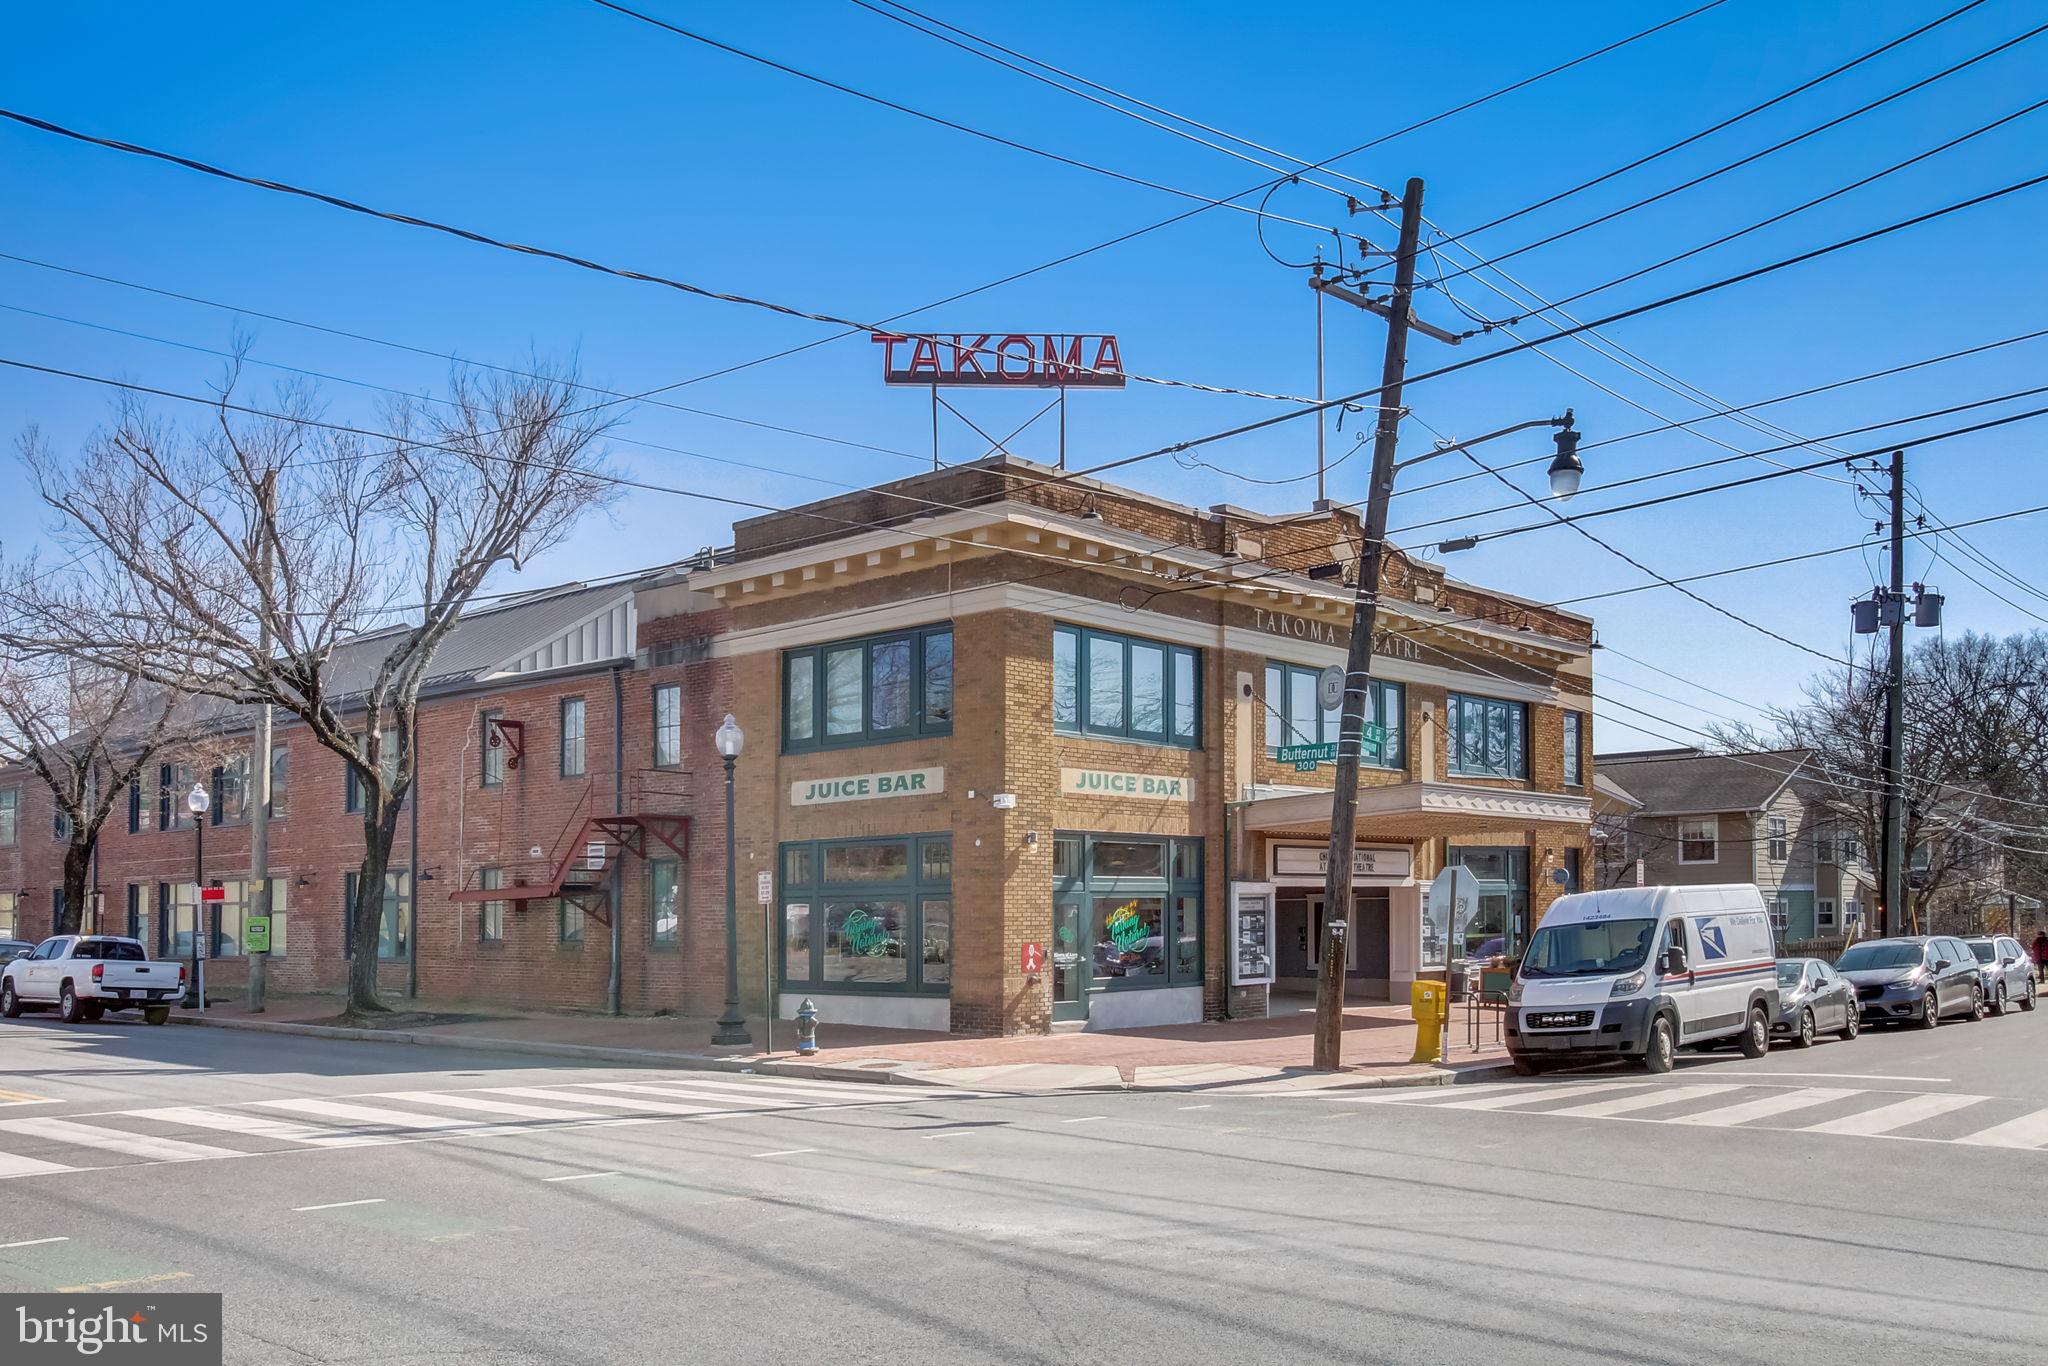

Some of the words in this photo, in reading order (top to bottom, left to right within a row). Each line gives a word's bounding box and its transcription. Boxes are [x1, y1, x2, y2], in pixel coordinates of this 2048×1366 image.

[871, 334, 1124, 382] TAKOMA
[1254, 608, 1335, 643] TAKOMA
[1349, 628, 1421, 660] EATRE
[1366, 726, 1372, 739] 4
[1281, 745, 1329, 760] Butternut
[1296, 761, 1316, 770] 300
[805, 778, 870, 800] JUICE
[878, 773, 926, 793] BAR
[1076, 772, 1136, 793] JUICE
[1142, 778, 1182, 796] BAR
[1353, 852, 1376, 862] ATIONAL
